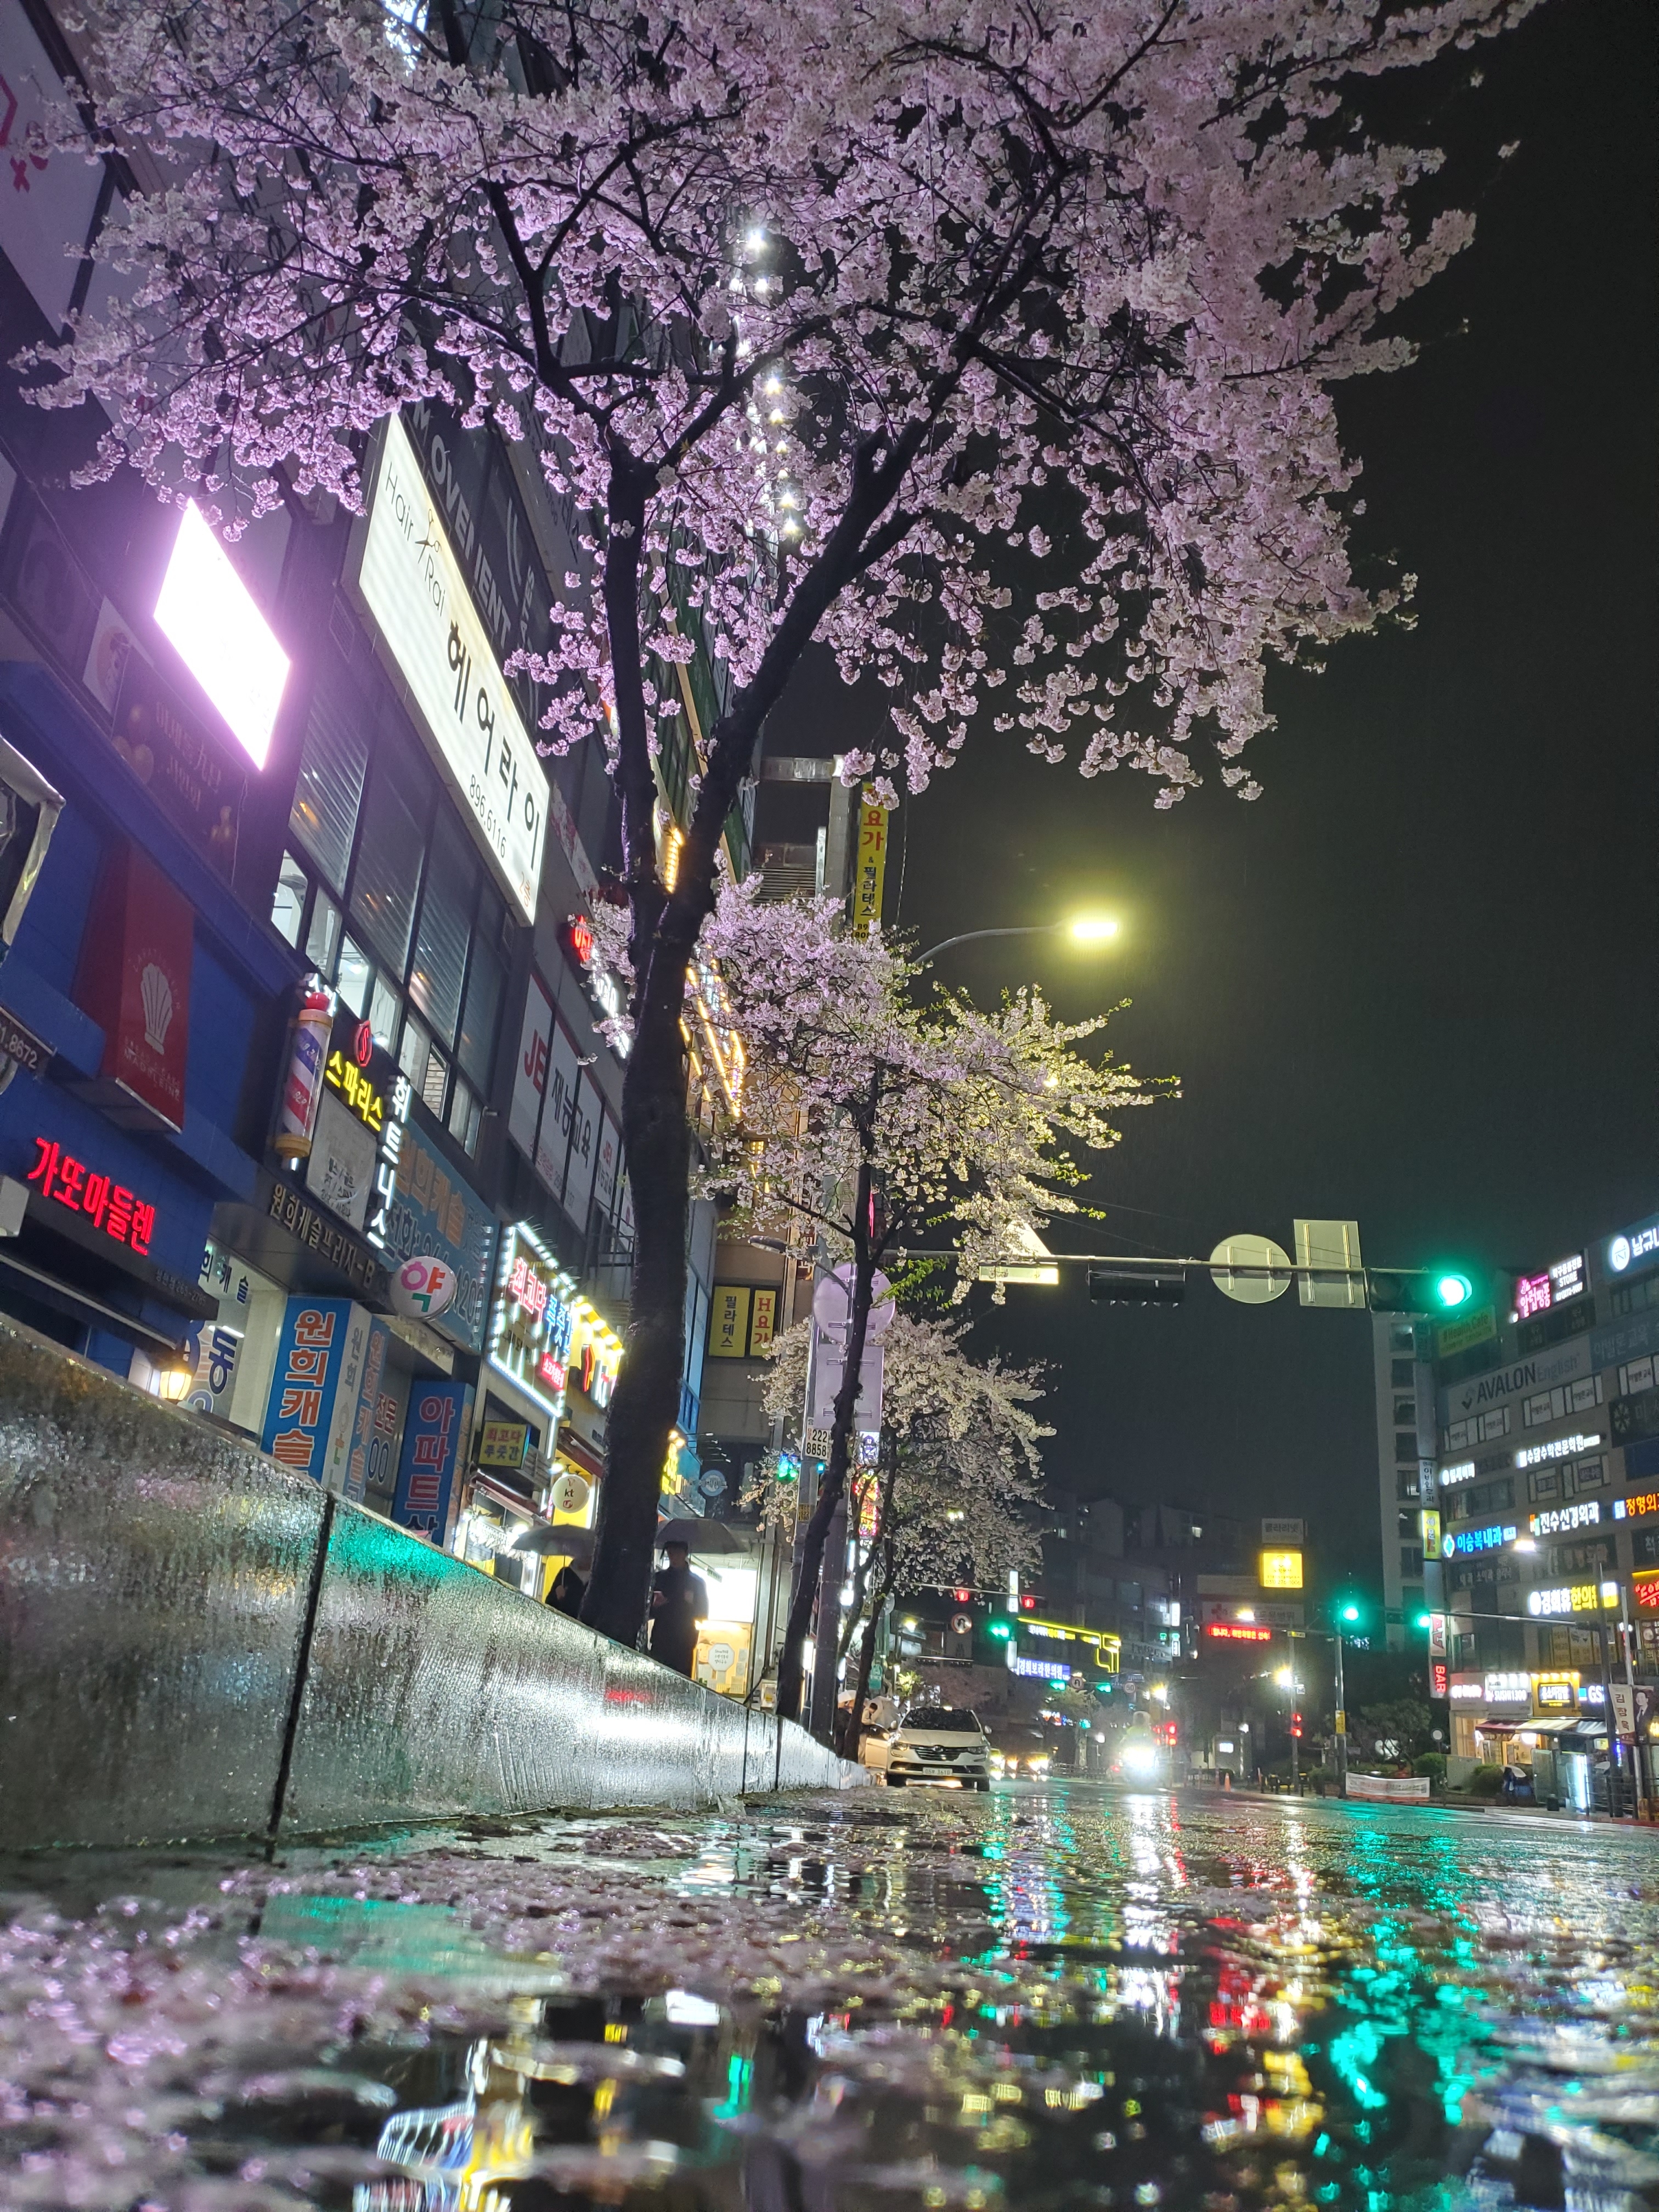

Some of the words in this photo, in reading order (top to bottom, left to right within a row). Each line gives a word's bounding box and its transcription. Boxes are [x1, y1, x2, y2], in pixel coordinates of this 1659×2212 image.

[385, 462, 414, 541] Hair
[425, 554, 445, 617] Rai
[447, 619, 540, 872] 헤어라이
[470, 774, 506, 859] 896.6116
[862, 810, 884, 851] 요가
[860, 866, 877, 917] 필라테스
[325, 1050, 382, 1131] 스파리스
[367, 1075, 411, 1250] 휘트니스
[27, 1137, 155, 1256] 가또마들렌
[400, 1261, 446, 1313] 약
[1520, 1282, 1551, 1317] 알럽핑퐁
[1559, 1270, 1578, 1288] STORE
[720, 1295, 737, 1347] 필라테스
[757, 1297, 772, 1312] H
[754, 1315, 770, 1345] 요가
[273, 1309, 336, 1468] 원희캐슬
[1477, 1362, 1536, 1404] AVALON
[805, 1442, 827, 1457] 8858
[812, 1429, 828, 1443] 222
[564, 1488, 574, 1498] kt
[1539, 1500, 1600, 1534] 진수신경외과
[1457, 1525, 1503, 1553] 이승복내과
[1019, 1659, 1063, 1680] 경희보라한의원
[1435, 1664, 1447, 1693] BAR
